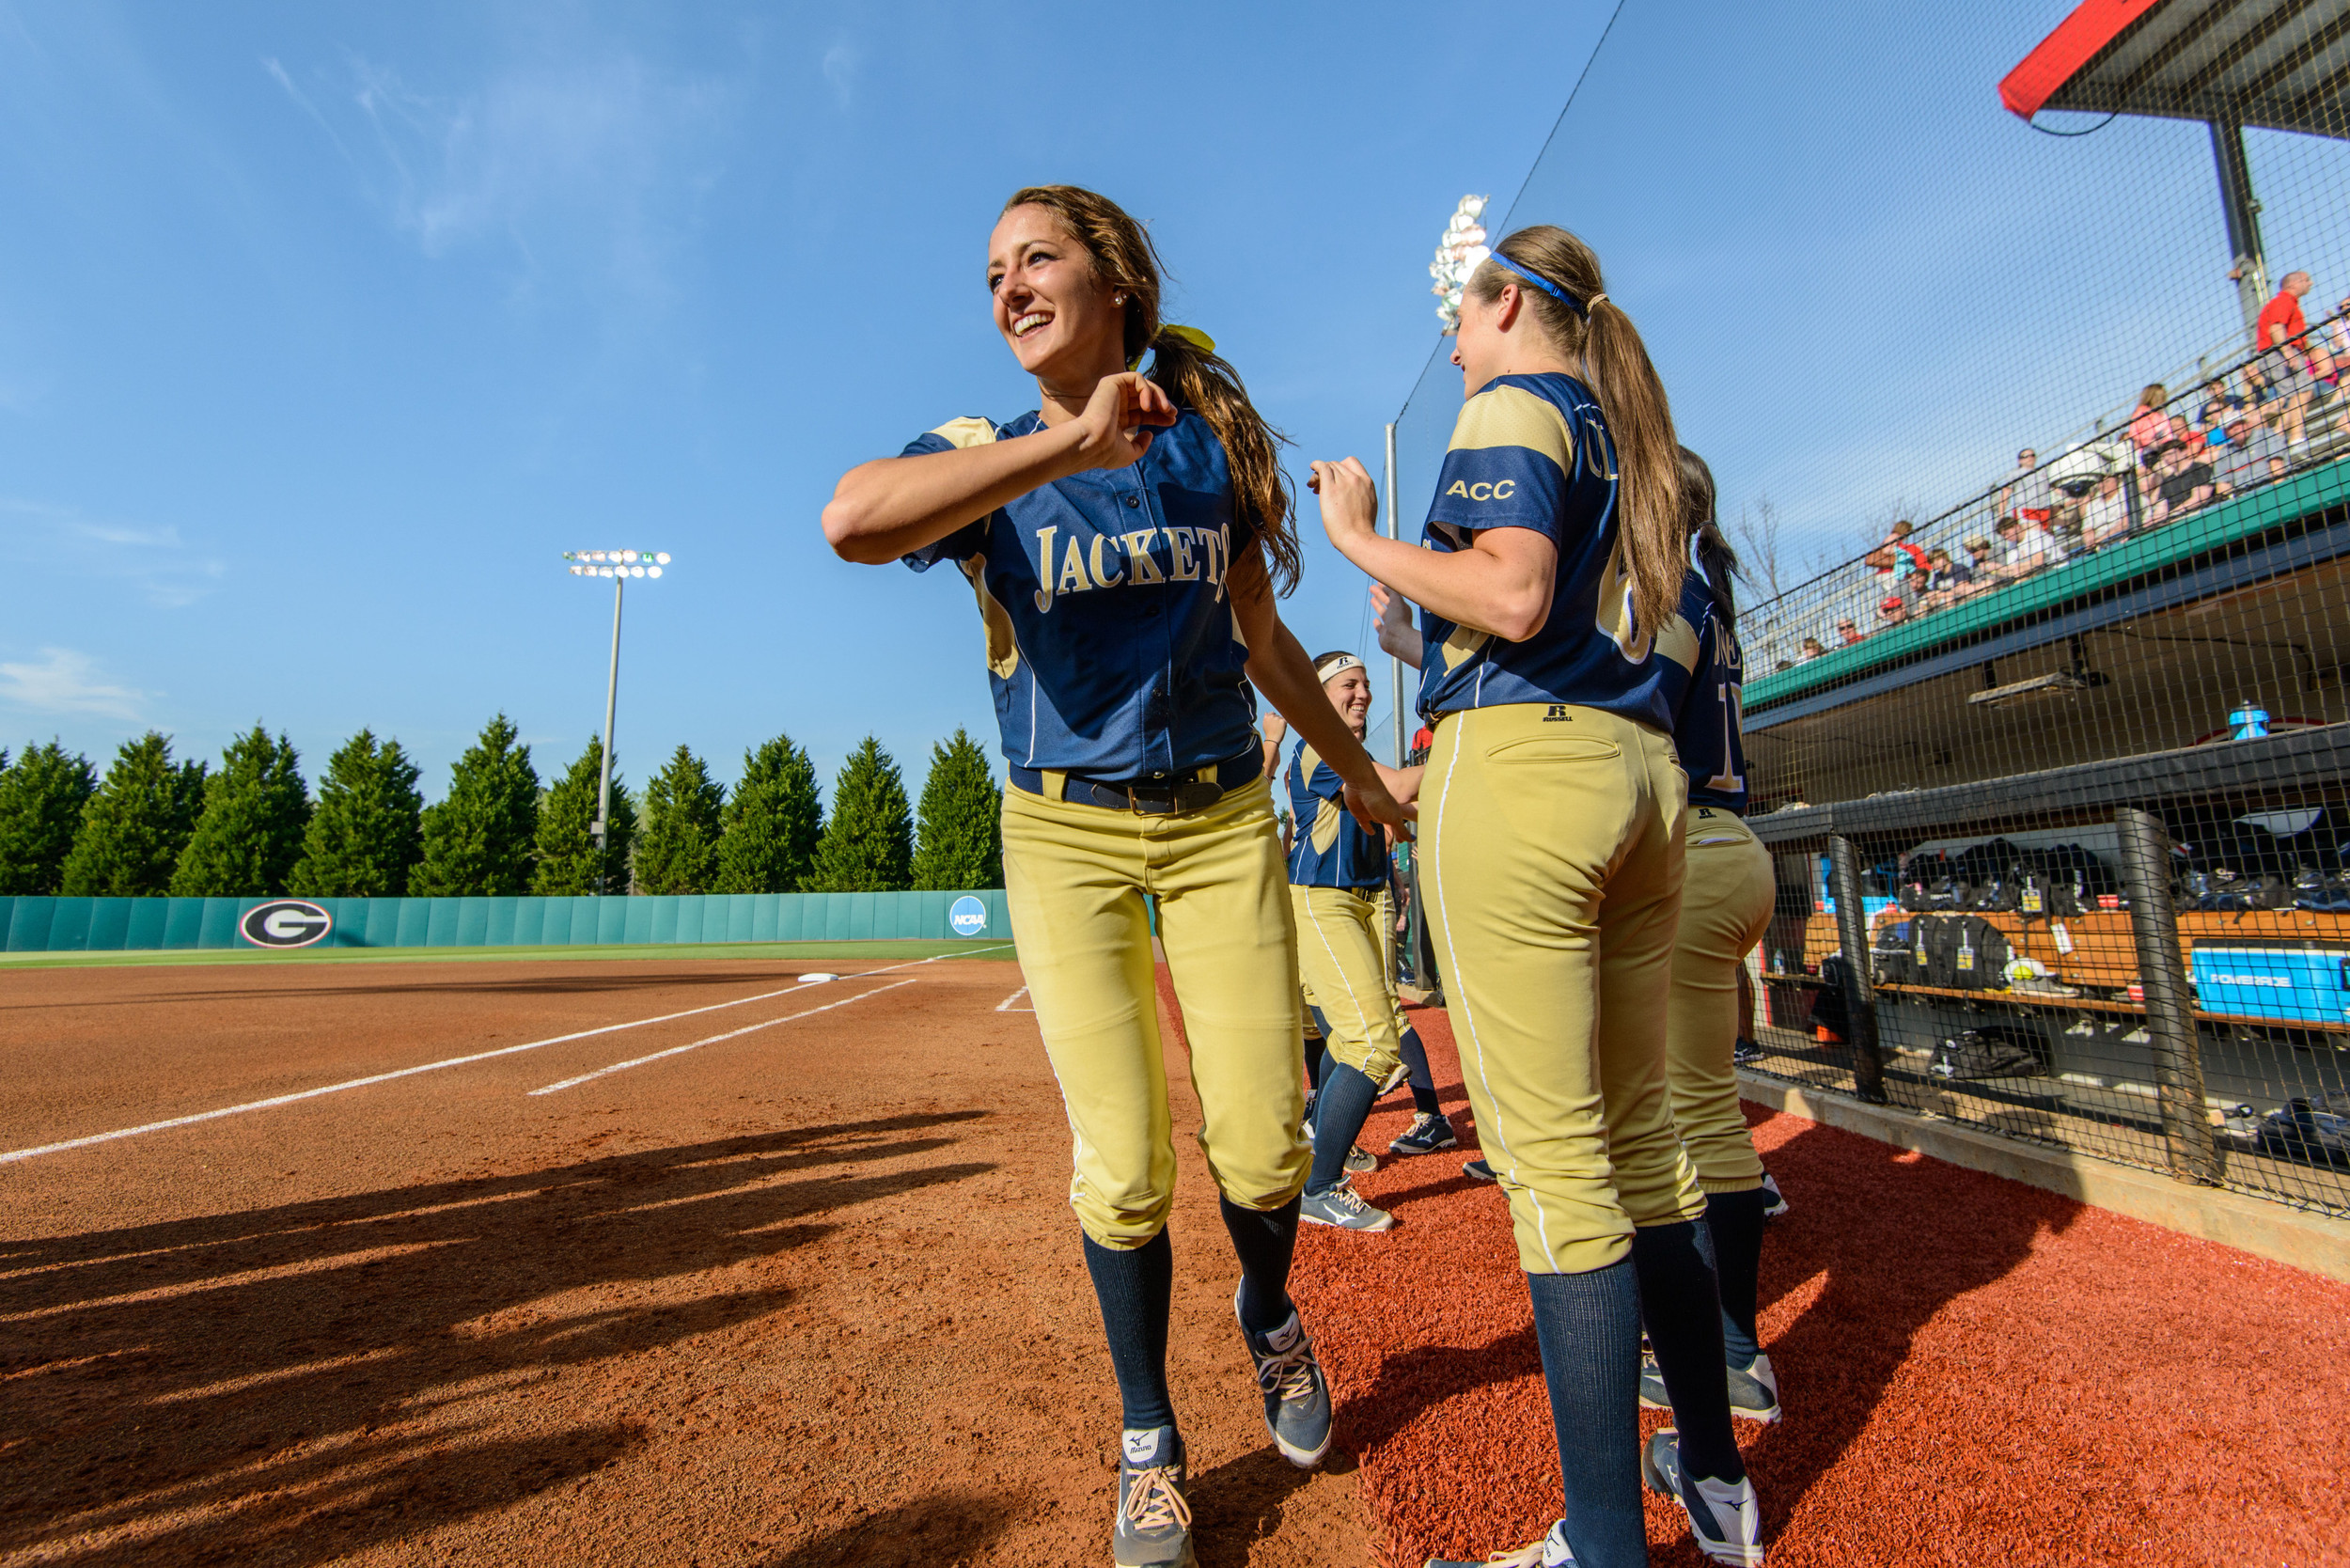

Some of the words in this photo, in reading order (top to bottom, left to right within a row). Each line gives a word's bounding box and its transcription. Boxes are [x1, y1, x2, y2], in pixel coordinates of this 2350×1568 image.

[1446, 479, 1516, 501] ACC
[242, 900, 331, 949] G
[953, 914, 984, 926] NCAA
[2210, 974, 2292, 987] POWERADE
